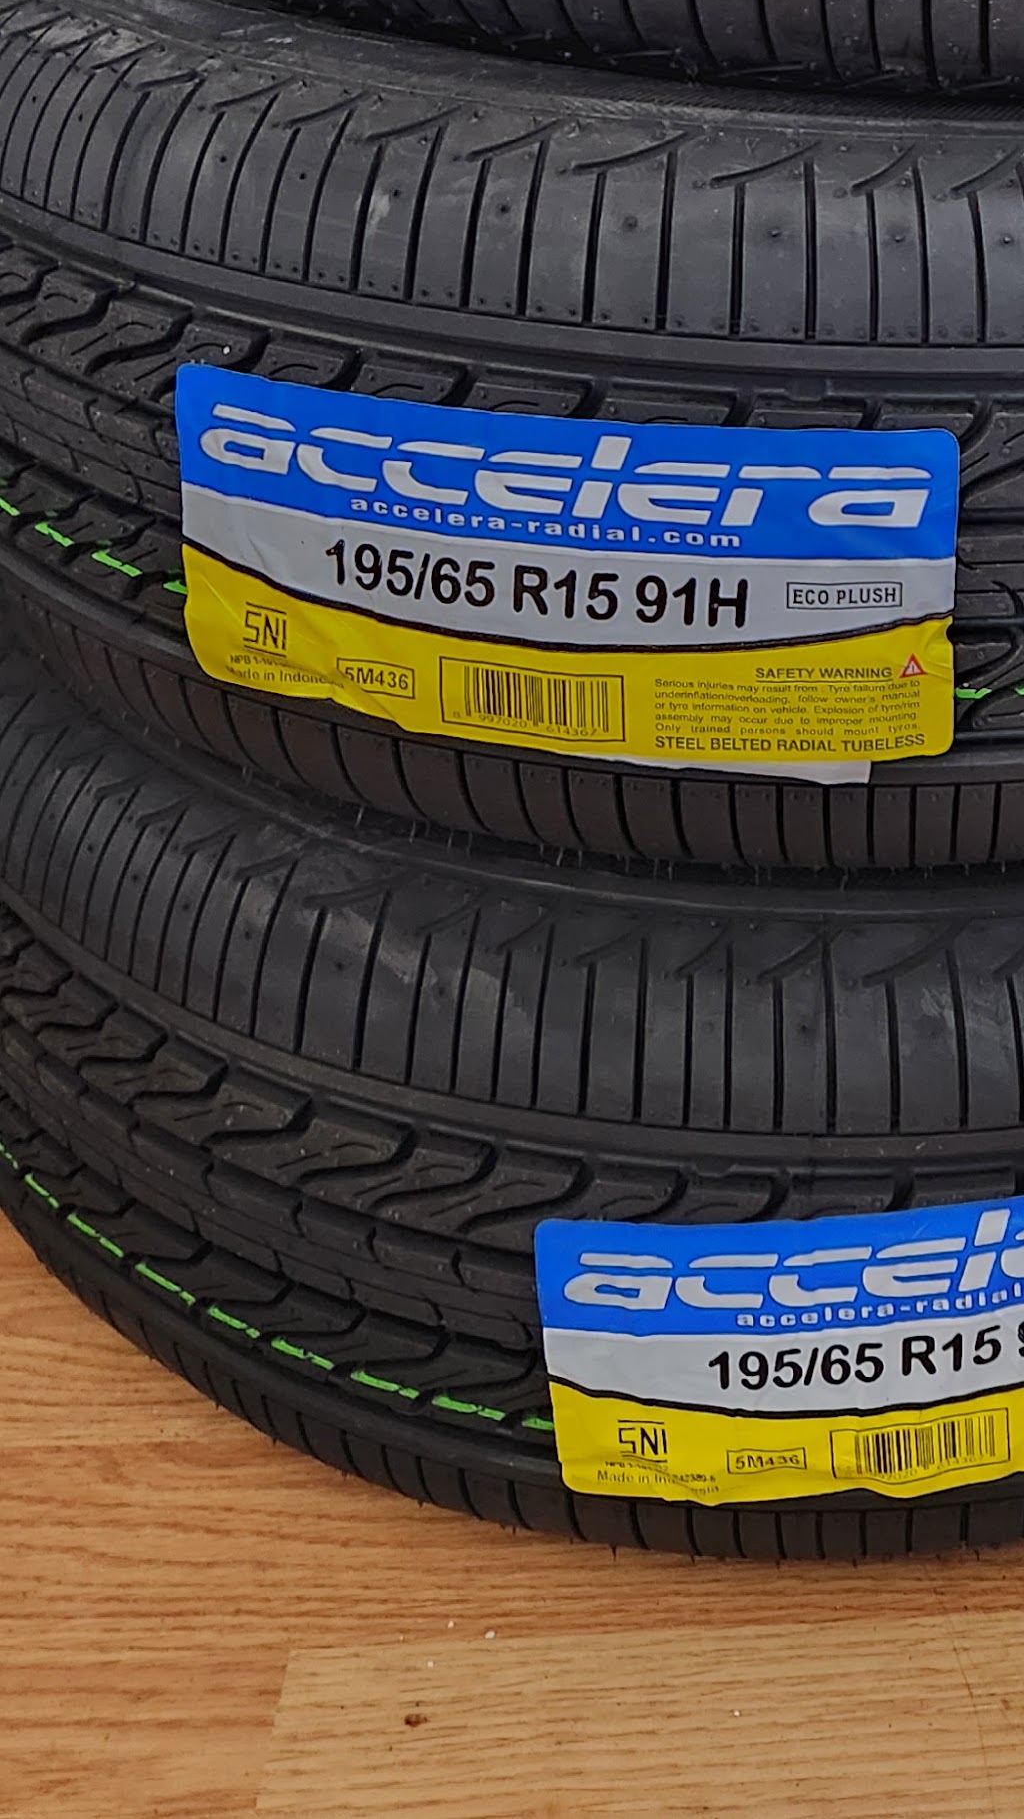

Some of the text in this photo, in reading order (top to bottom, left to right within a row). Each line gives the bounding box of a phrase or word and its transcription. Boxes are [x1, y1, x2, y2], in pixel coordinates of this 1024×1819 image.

[200, 402, 932, 528] accelera
[350, 498, 740, 548] accelera-radial.com
[326, 539, 748, 628] 195/65 R15 91H
[792, 588, 896, 605] ECO PLUSH
[243, 610, 287, 650] SNI
[264, 669, 275, 681] in
[345, 667, 409, 690] 5M436
[755, 667, 893, 679] SAFETY WARNING
[655, 679, 920, 694] Serious injuries may result from Tyre failure due to
[655, 690, 920, 705] underinflation/overloading, follow owner's manual
[655, 701, 665, 710] or
[669, 702, 689, 712] tyre
[692, 702, 750, 712] information
[753, 705, 767, 714] on
[813, 705, 865, 716] Explosion
[868, 704, 879, 714] of
[881, 701, 920, 712] tyre/rim
[655, 712, 704, 725] assembly
[711, 715, 733, 725] may
[739, 715, 767, 725] occur
[774, 717, 794, 725] due
[800, 717, 811, 725] to
[816, 717, 863, 727] improper
[655, 723, 682, 734] Only
[690, 724, 731, 733] trained
[740, 726, 786, 736] persons
[795, 726, 834, 736] should
[843, 727, 879, 735] mount
[655, 733, 925, 752] STEEL BELTED RADIAL TUBELESS
[708, 1343, 884, 1390] 195/65
[901, 1325, 1002, 1376] R15
[618, 1427, 667, 1456] SNI
[735, 1455, 800, 1470] 5M436
[597, 1469, 634, 1483] Made
